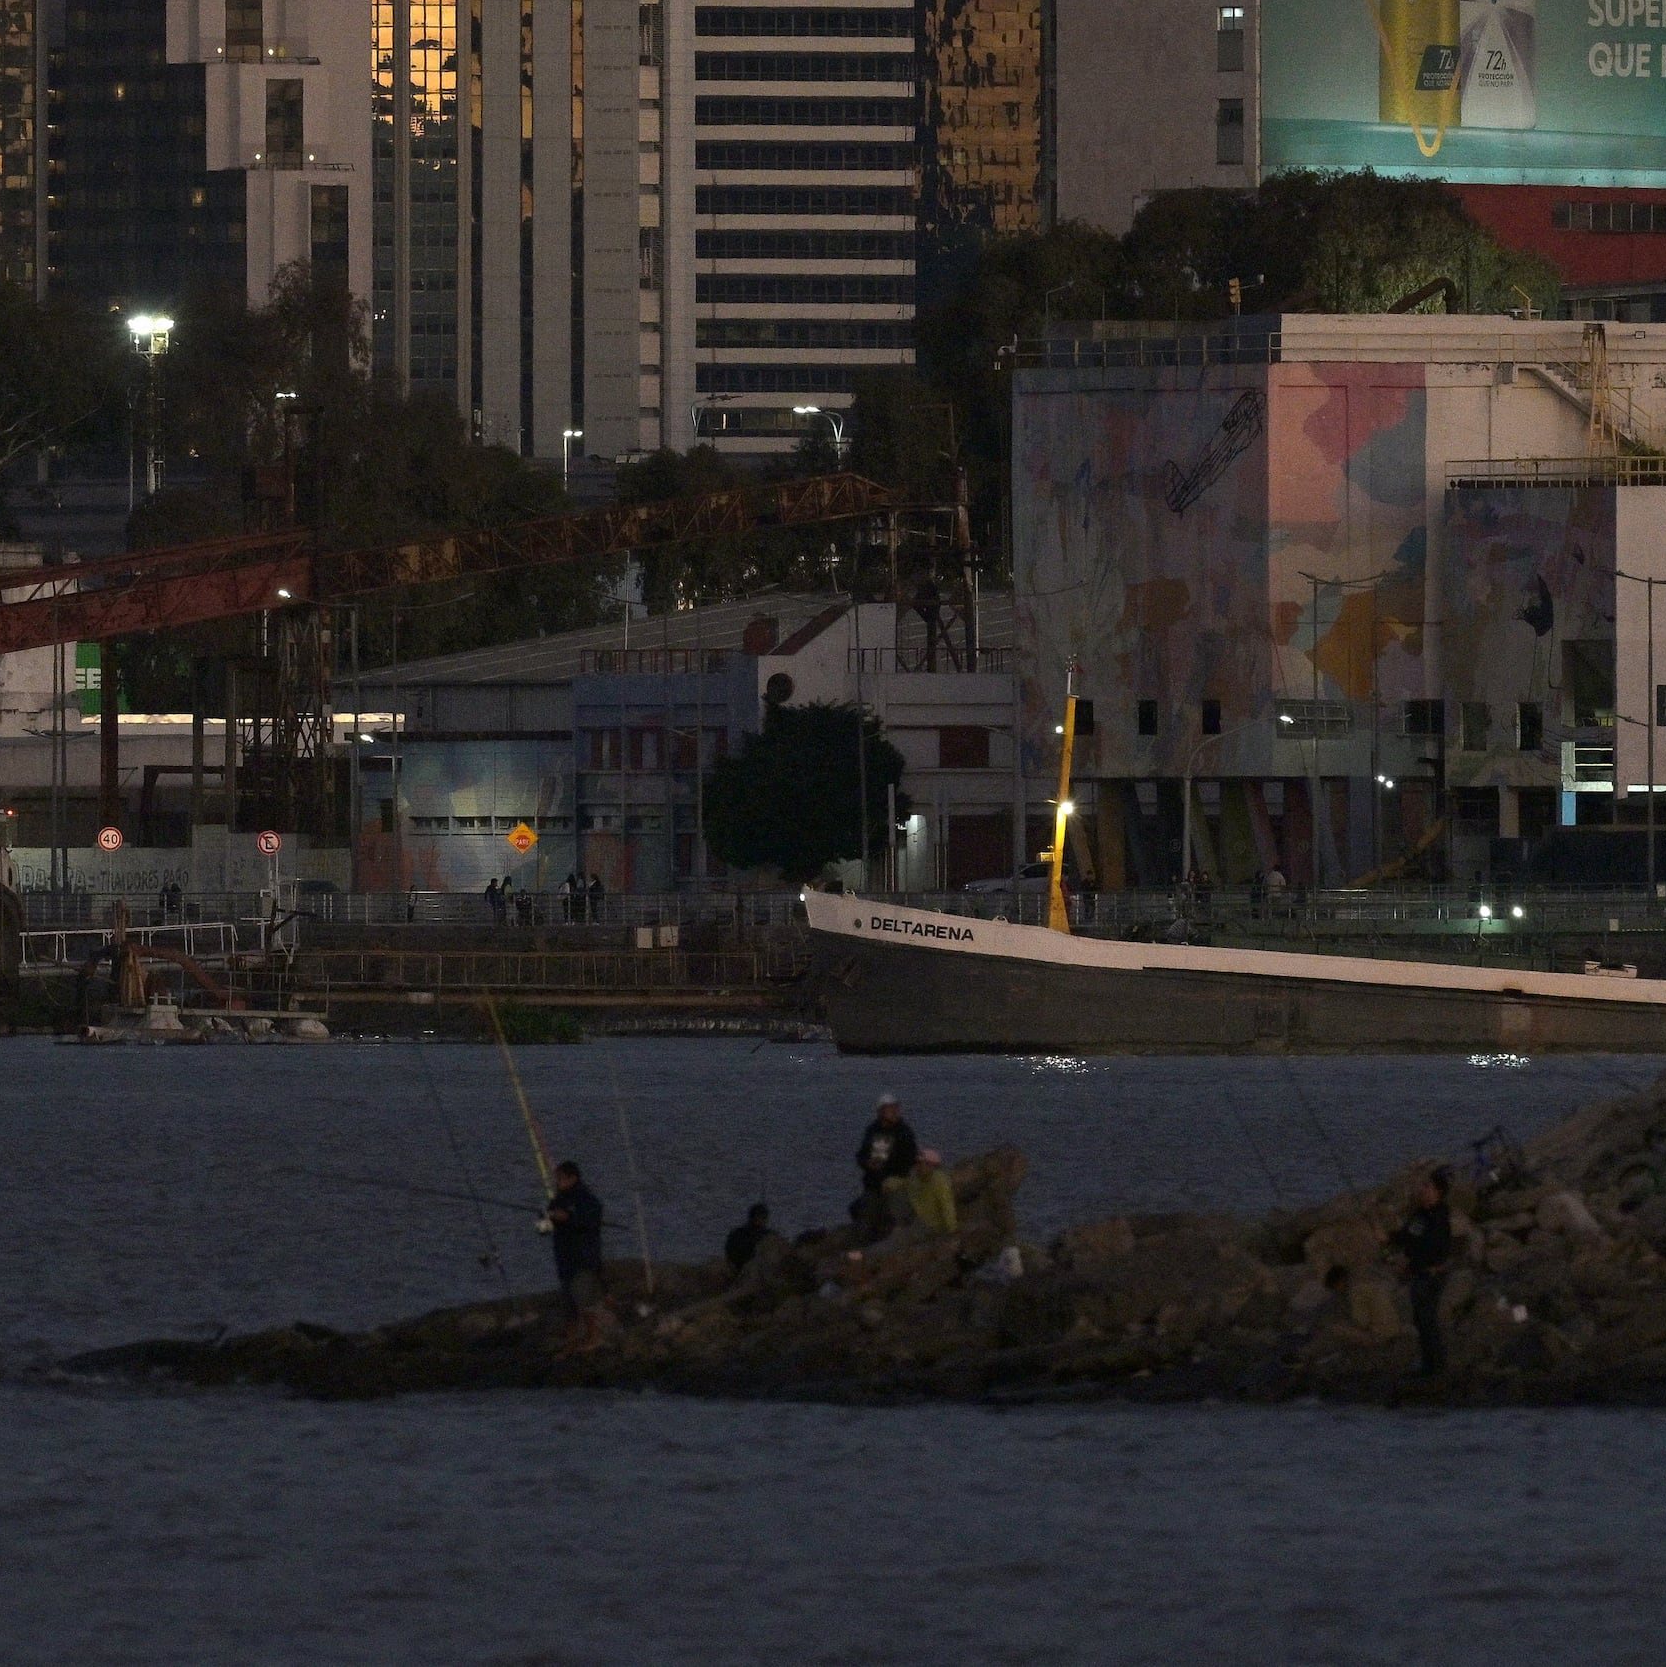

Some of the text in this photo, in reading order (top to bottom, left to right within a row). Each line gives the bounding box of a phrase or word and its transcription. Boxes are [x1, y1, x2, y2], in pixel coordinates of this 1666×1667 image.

[1486, 50, 1507, 70] 72h
[1588, 41, 1652, 78] QUE
[102, 833, 119, 845] 40
[870, 916, 975, 942] DELTARENA
